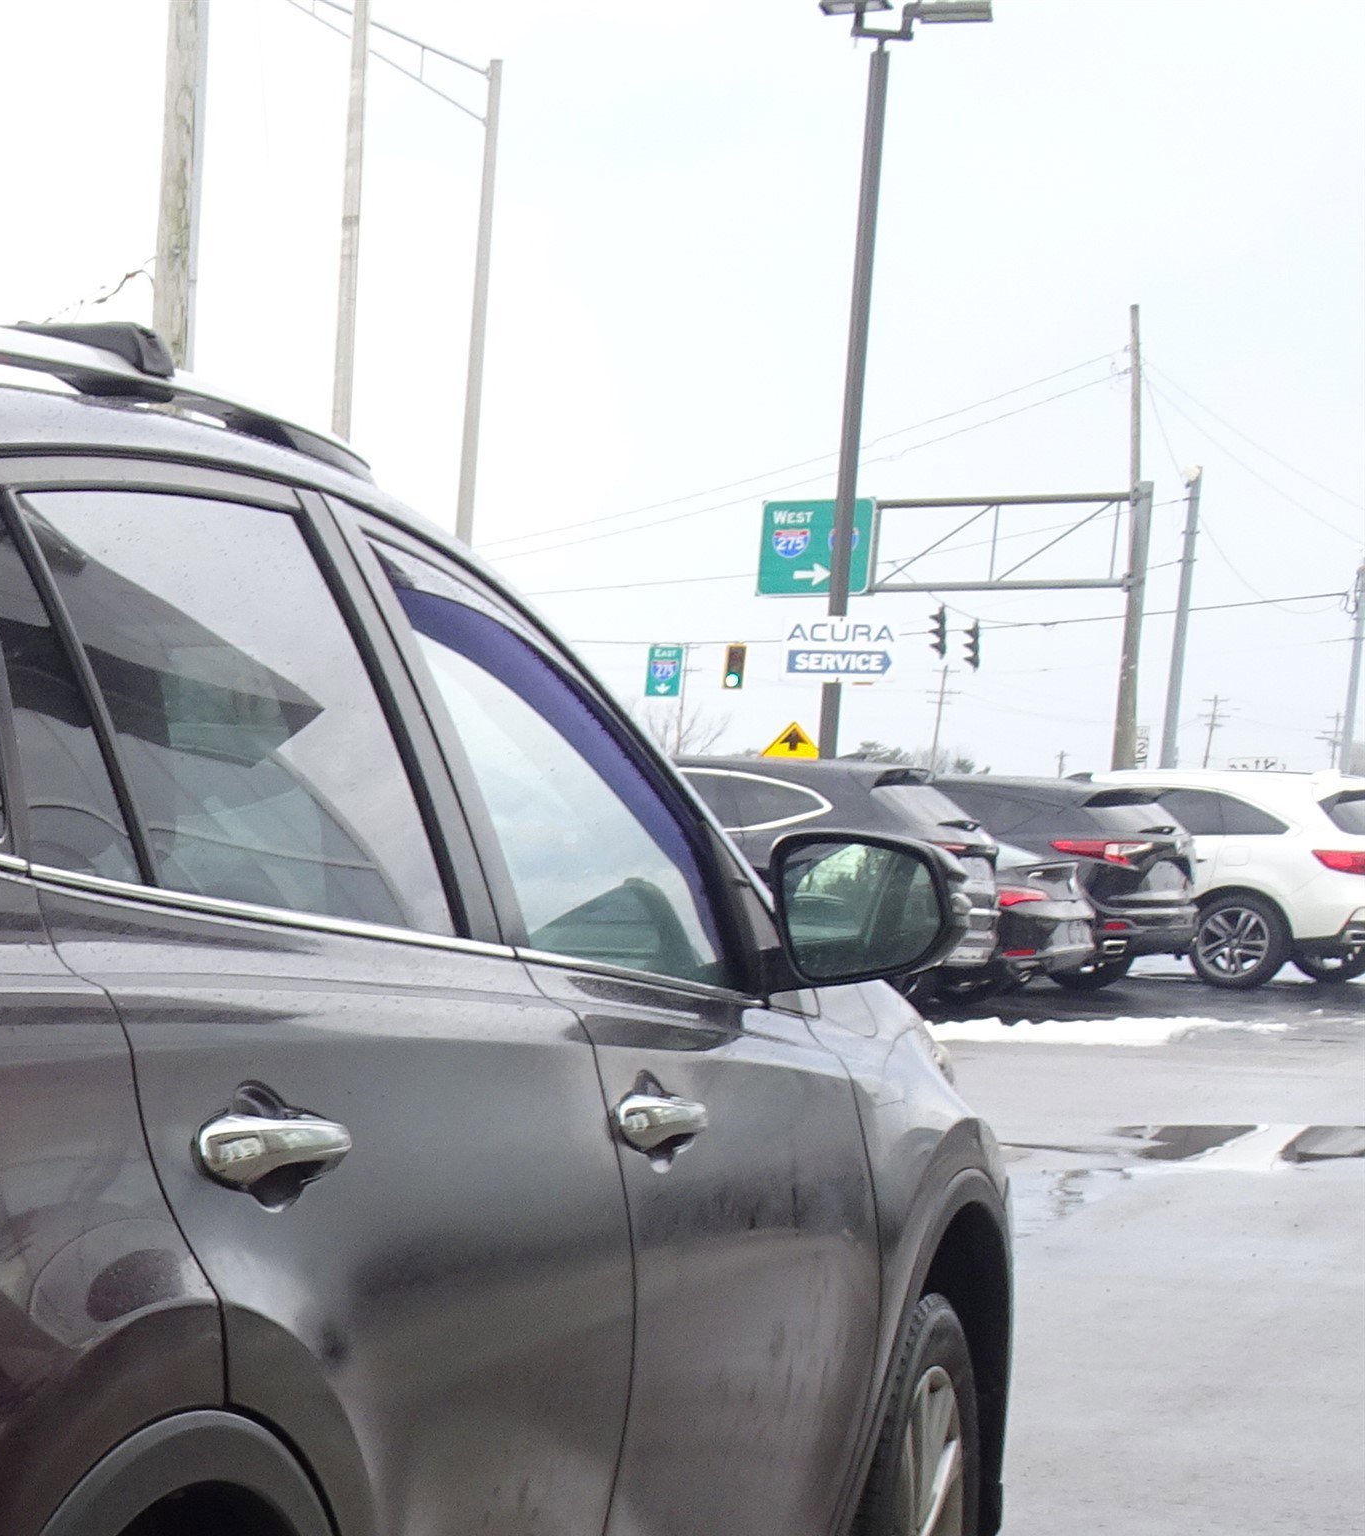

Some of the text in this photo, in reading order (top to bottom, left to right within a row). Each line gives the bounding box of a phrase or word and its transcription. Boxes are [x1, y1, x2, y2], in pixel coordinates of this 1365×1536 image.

[773, 510, 814, 524] WEST
[776, 536, 805, 550] 275
[787, 623, 895, 642] ACURA
[794, 653, 884, 671] SERVICE
